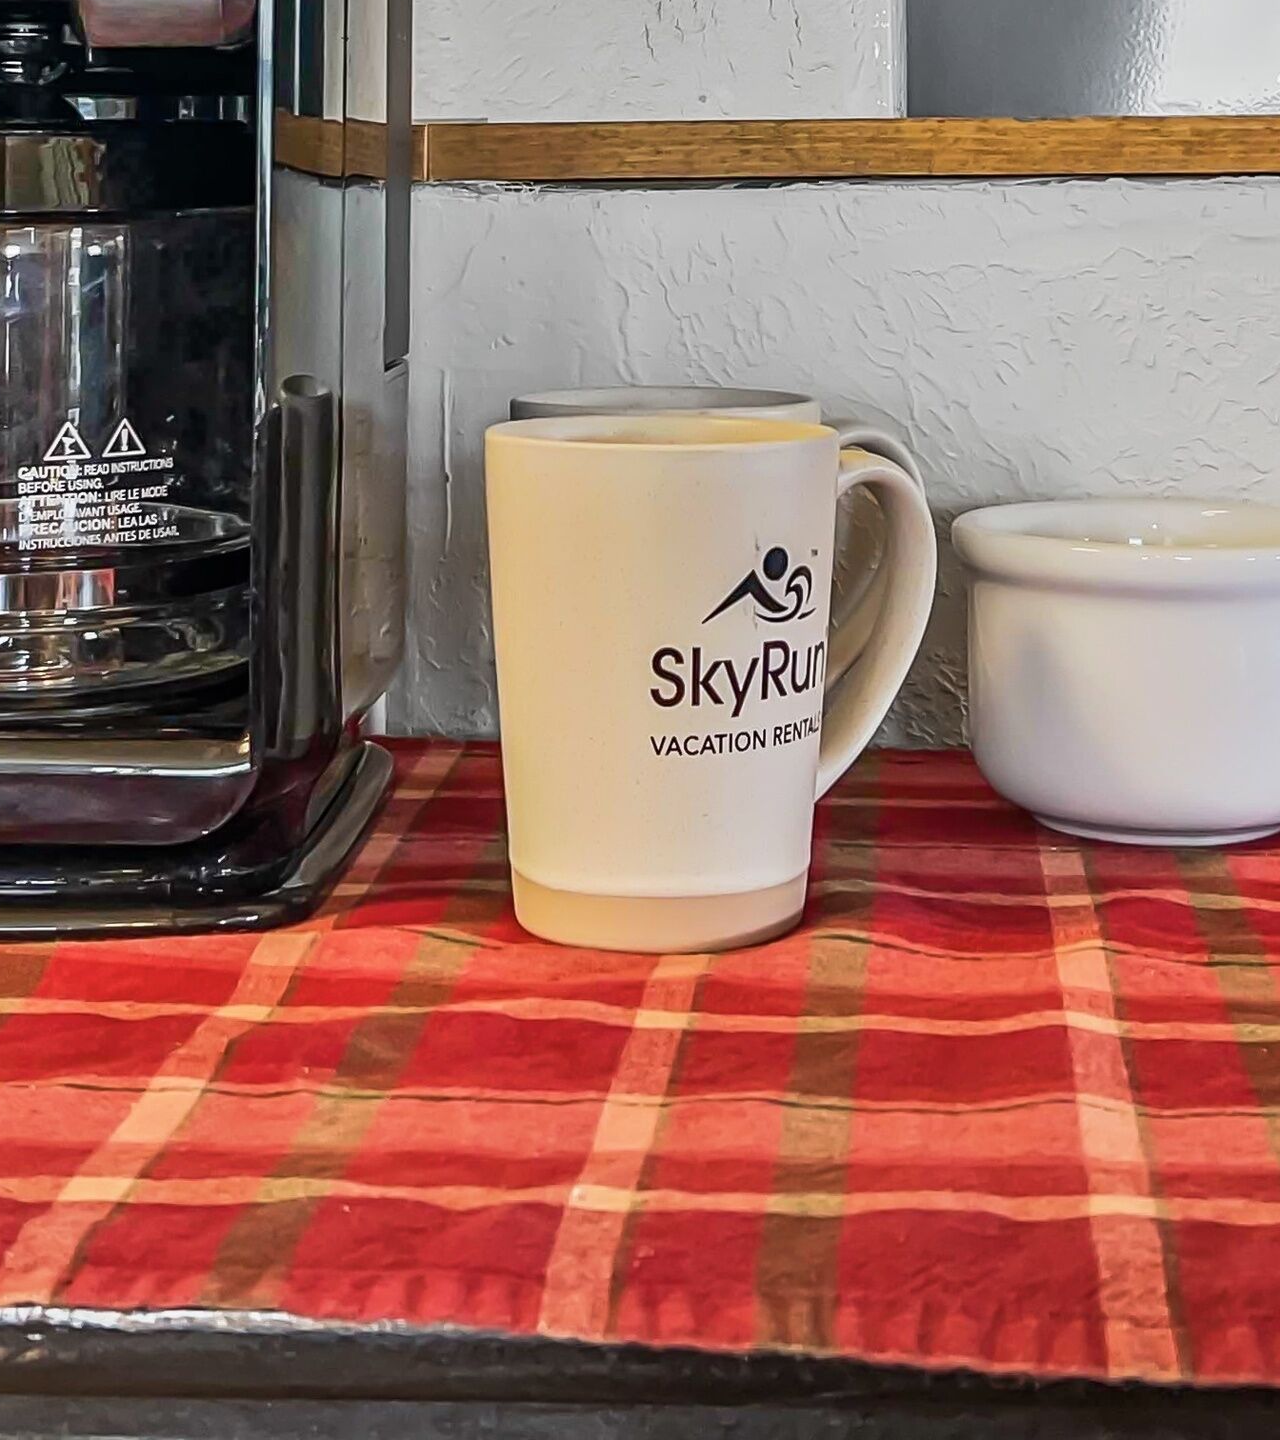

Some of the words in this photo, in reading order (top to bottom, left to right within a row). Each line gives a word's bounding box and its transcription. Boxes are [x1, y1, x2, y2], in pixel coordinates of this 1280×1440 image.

[17, 464, 83, 481] CAUTION:
[84, 463, 110, 477] READ
[111, 456, 174, 474] INSTRUCTIONS
[17, 490, 102, 509] ATTENTION:
[105, 489, 127, 502] LIRE
[128, 487, 140, 500] LE
[140, 484, 169, 499] MODE
[18, 480, 66, 495] BEFORE
[67, 477, 105, 492] USING.
[18, 508, 70, 523] DEMPLO
[118, 516, 138, 529] LEA
[138, 513, 158, 527] LAS
[18, 534, 101, 551] INSTRUCCIONES
[103, 530, 137, 544] ANTES
[138, 528, 152, 541] DE
[649, 639, 826, 719] SkyRun
[649, 728, 767, 757] VACATION
